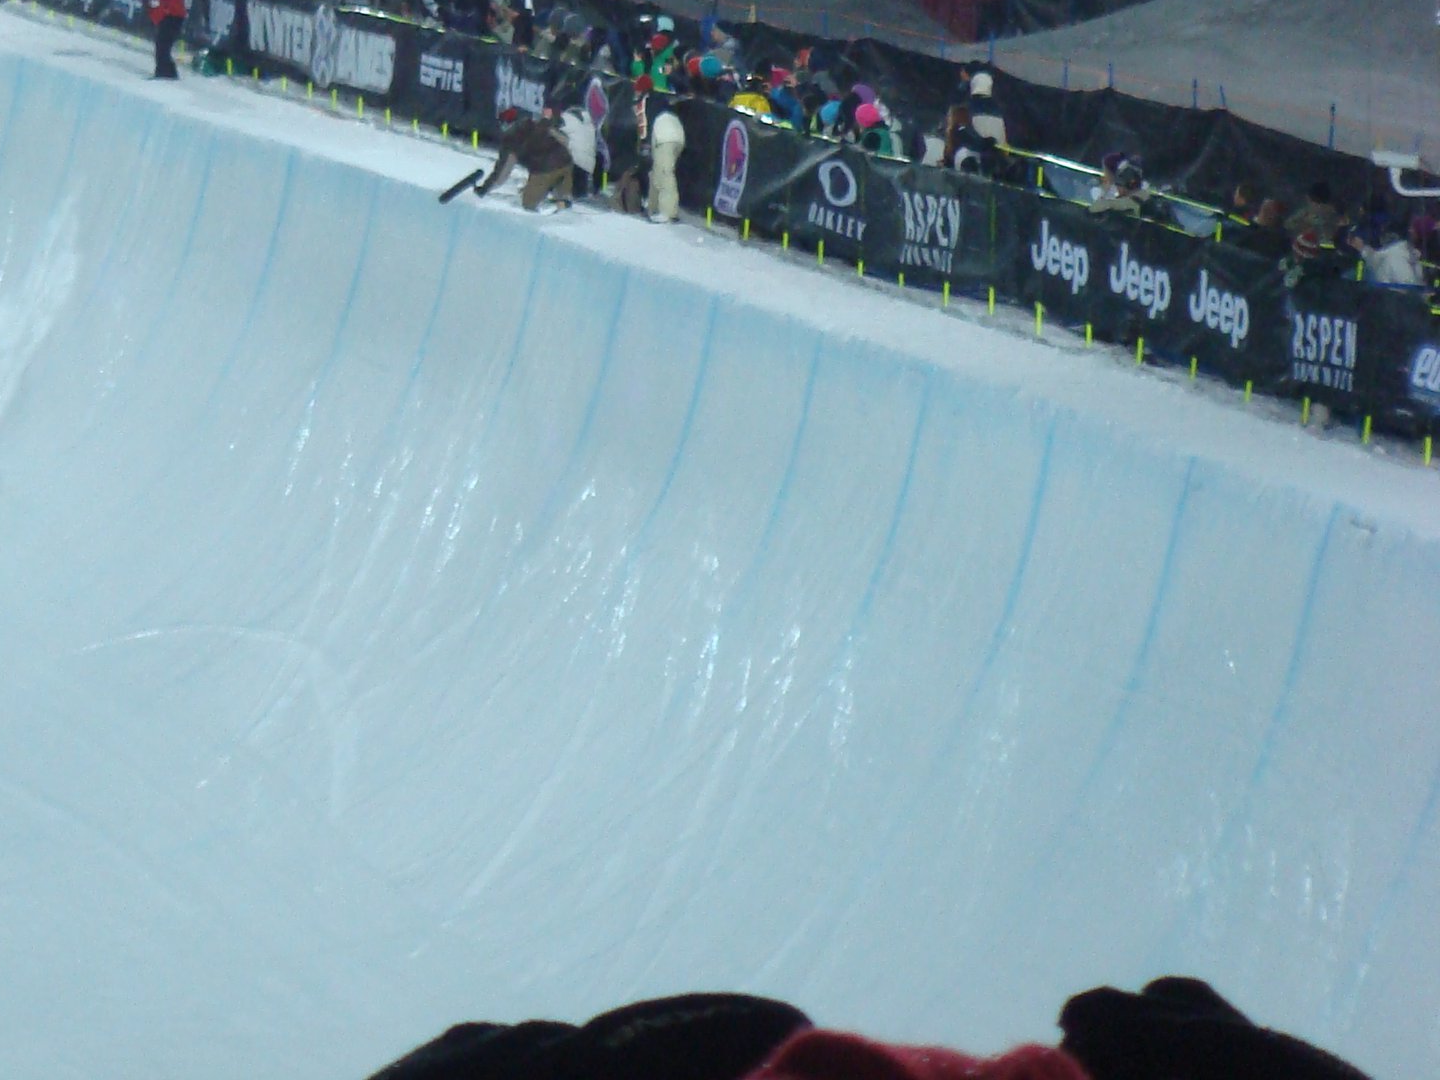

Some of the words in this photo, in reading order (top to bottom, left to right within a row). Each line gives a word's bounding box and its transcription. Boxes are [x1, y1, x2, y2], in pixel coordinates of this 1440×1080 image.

[808, 201, 867, 241] OAKLEY
[903, 191, 960, 249] ASPEN
[1031, 217, 1090, 295] Jeep
[1109, 241, 1171, 320] Jeep
[1189, 269, 1249, 349] Jeep
[1293, 314, 1357, 368] ASPEN
